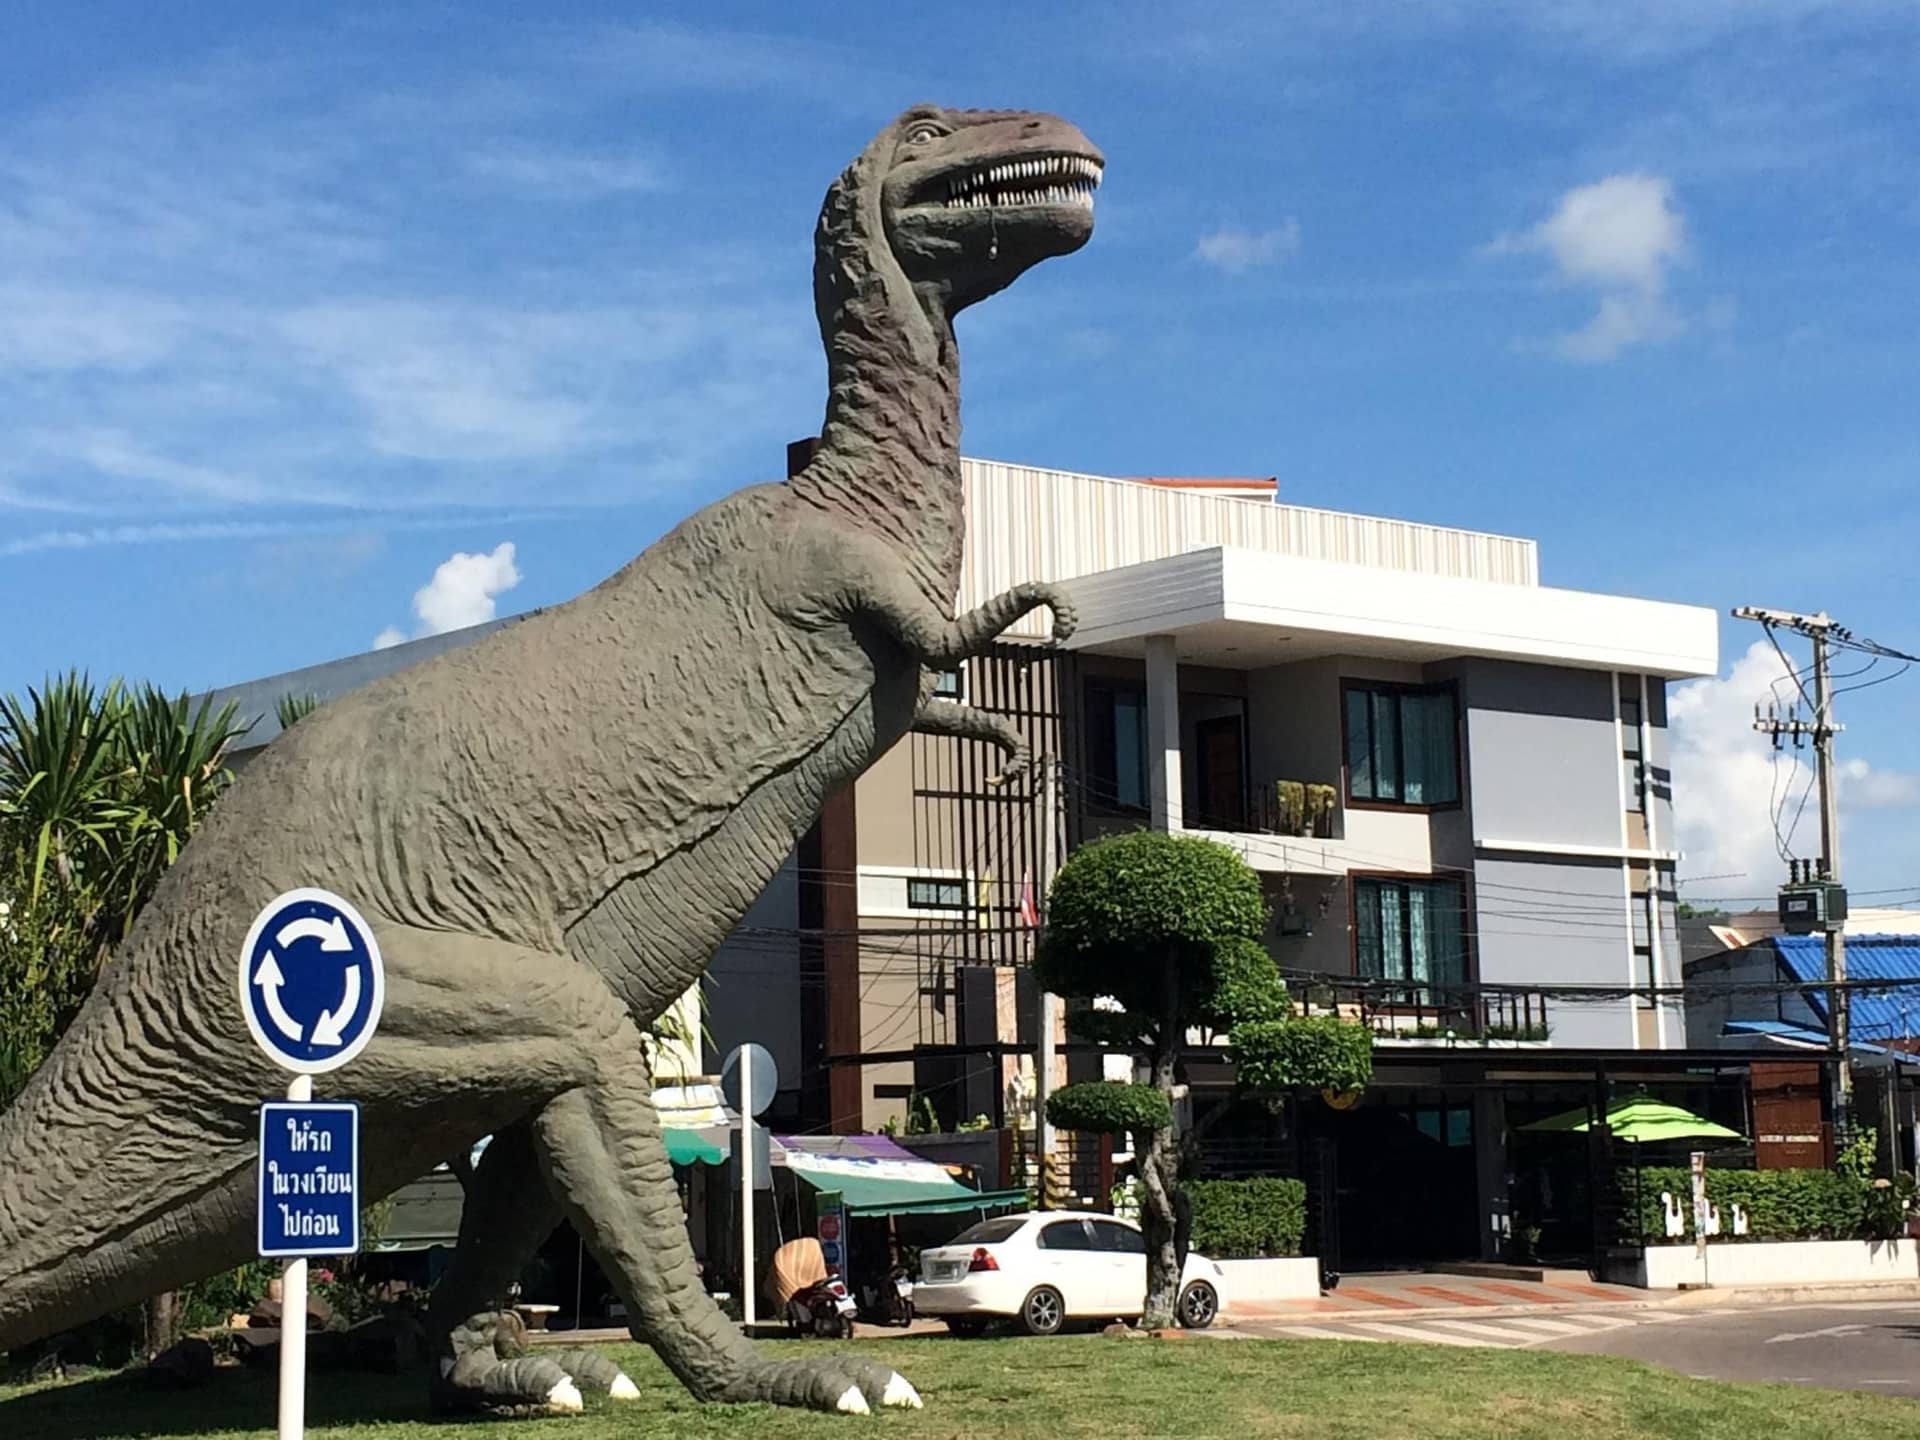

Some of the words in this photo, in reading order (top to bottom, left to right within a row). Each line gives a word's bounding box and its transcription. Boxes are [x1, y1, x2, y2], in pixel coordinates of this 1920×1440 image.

[287, 1118, 331, 1152] ให้รถ
[268, 1160, 352, 1195] ในวงเวียน
